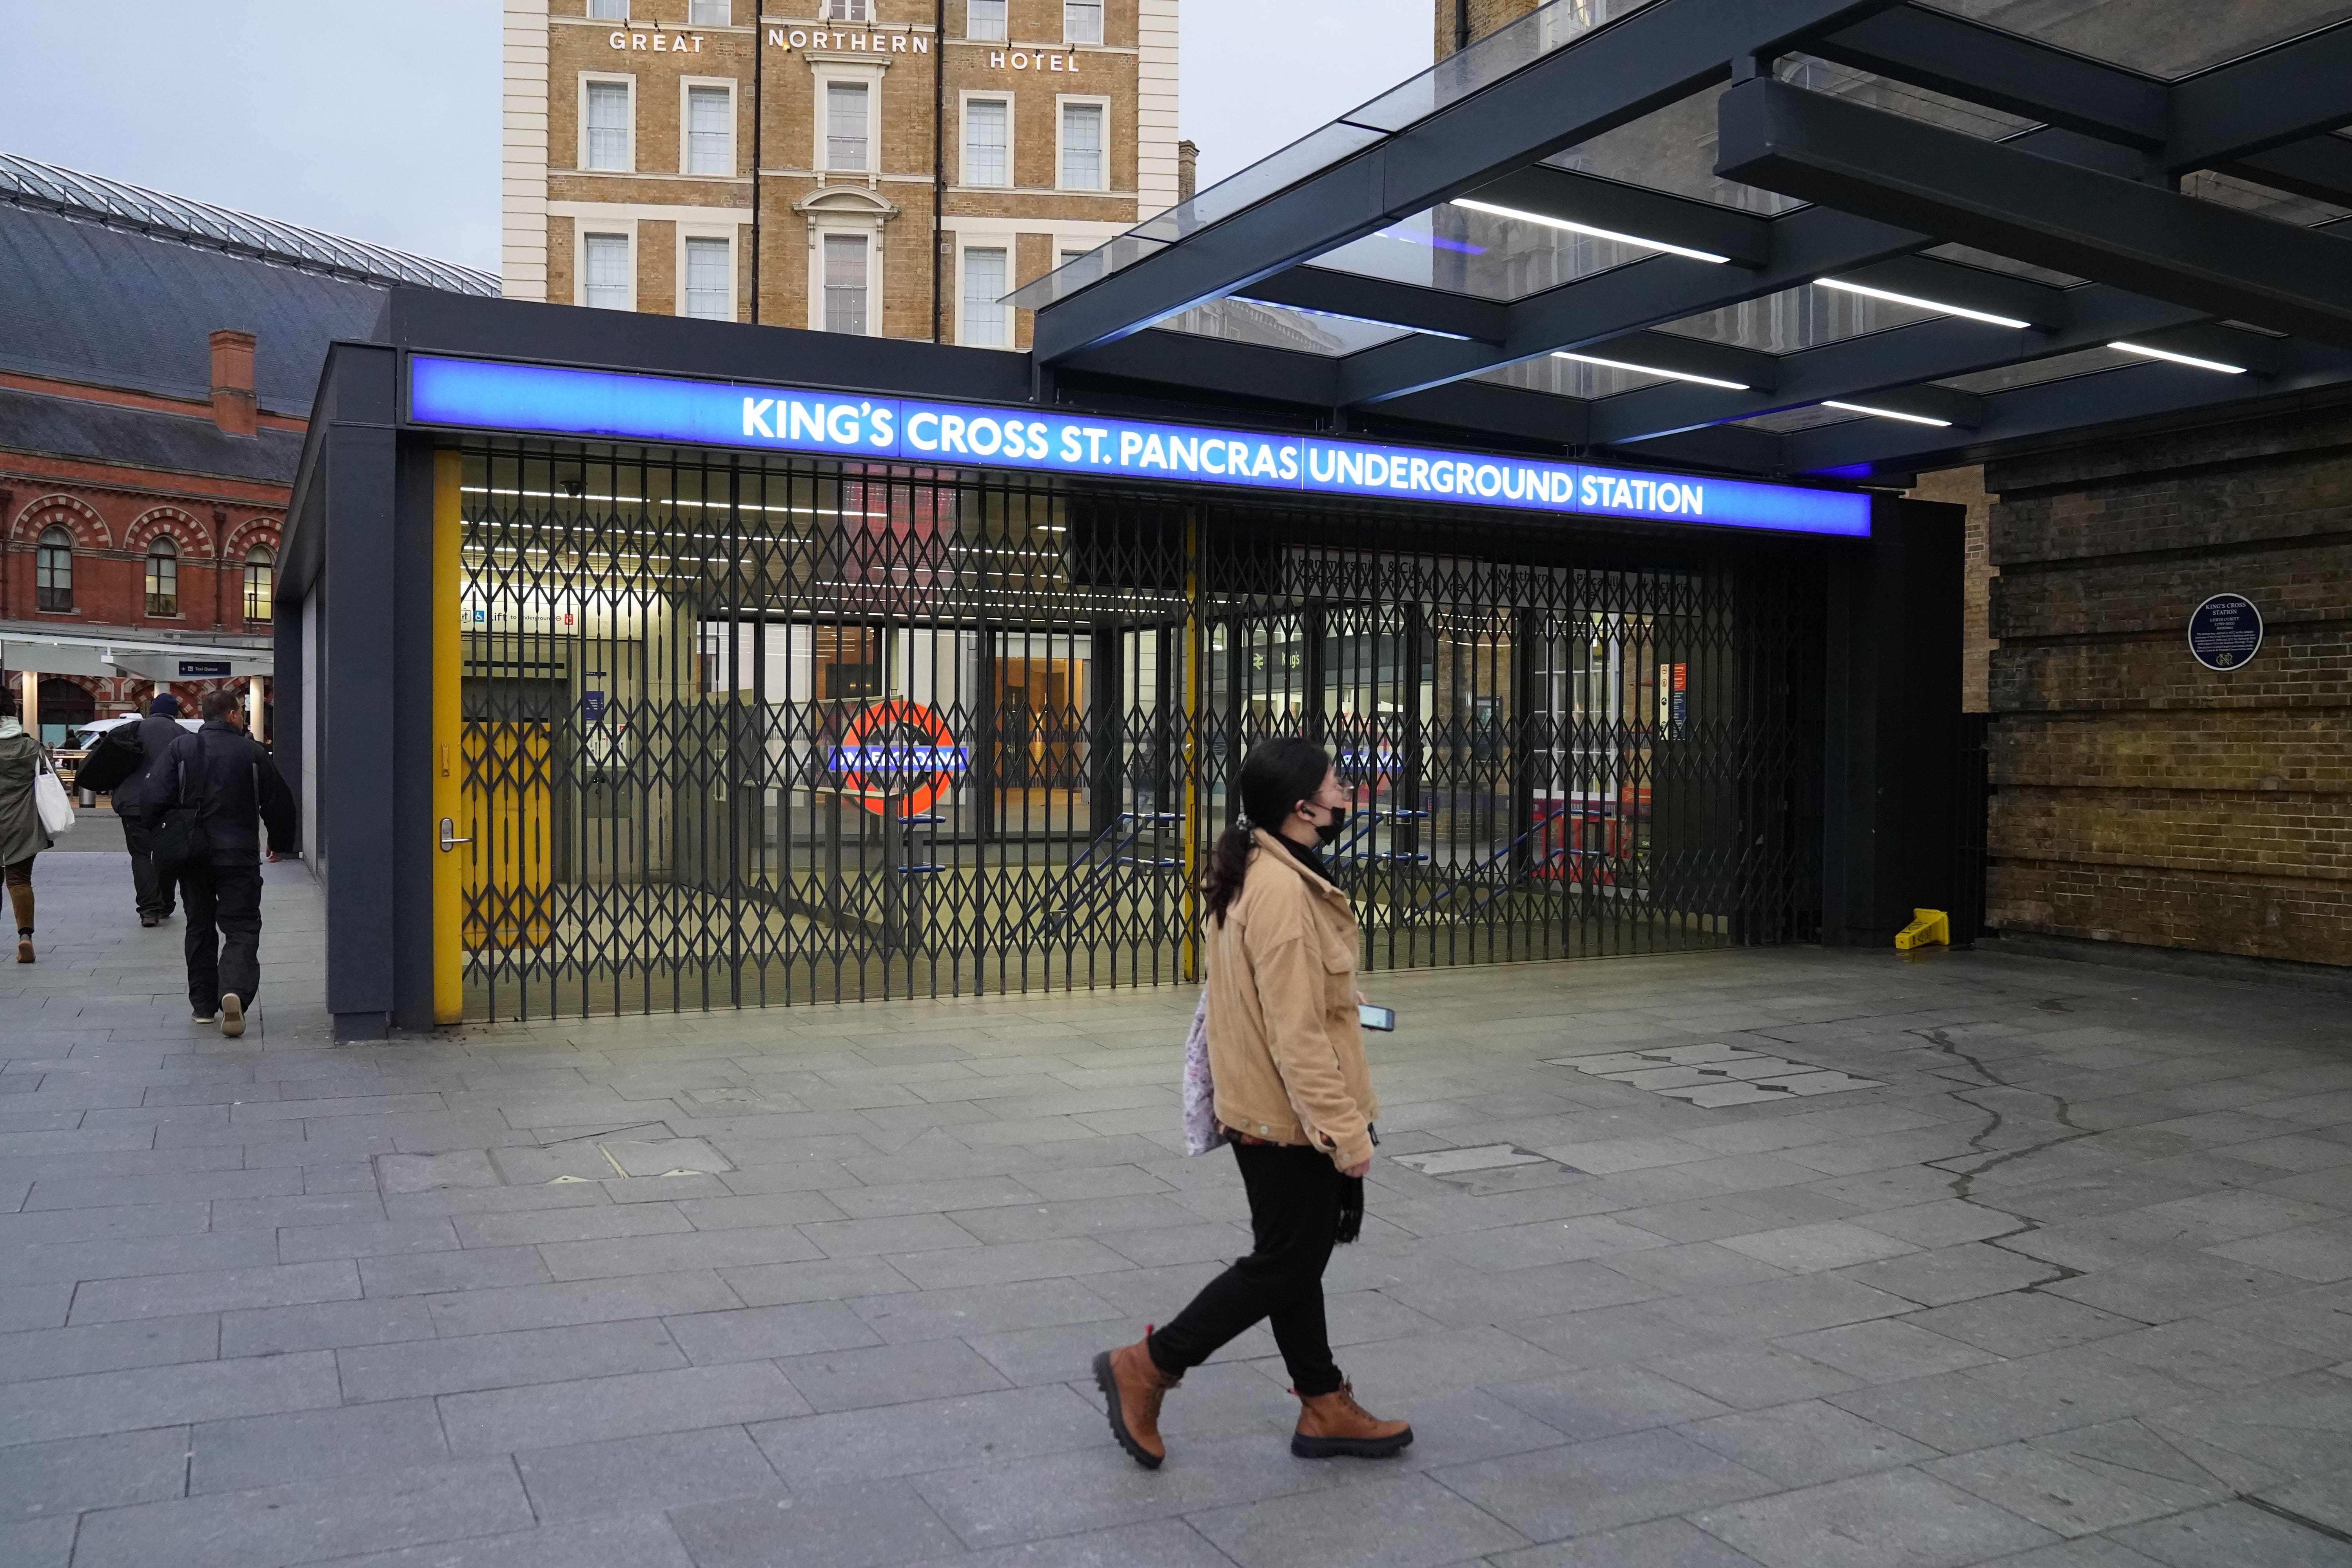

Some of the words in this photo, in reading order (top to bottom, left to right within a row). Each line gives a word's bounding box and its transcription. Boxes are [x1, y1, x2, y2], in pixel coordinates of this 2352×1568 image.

[610, 33, 704, 53] GREAT
[769, 29, 927, 53] NORTHERN
[991, 52, 1079, 72] HOTEL
[743, 397, 893, 447] KING'S
[907, 412, 1049, 460] CROSS
[1060, 426, 1112, 464] ST.
[1121, 431, 1298, 480] PANCRAS
[1310, 448, 1573, 503] UNDERGROUND
[1581, 475, 1703, 515] STATION
[1388, 561, 1394, 572] &
[489, 612, 507, 622] ift
[1282, 650, 1300, 668] Kg's
